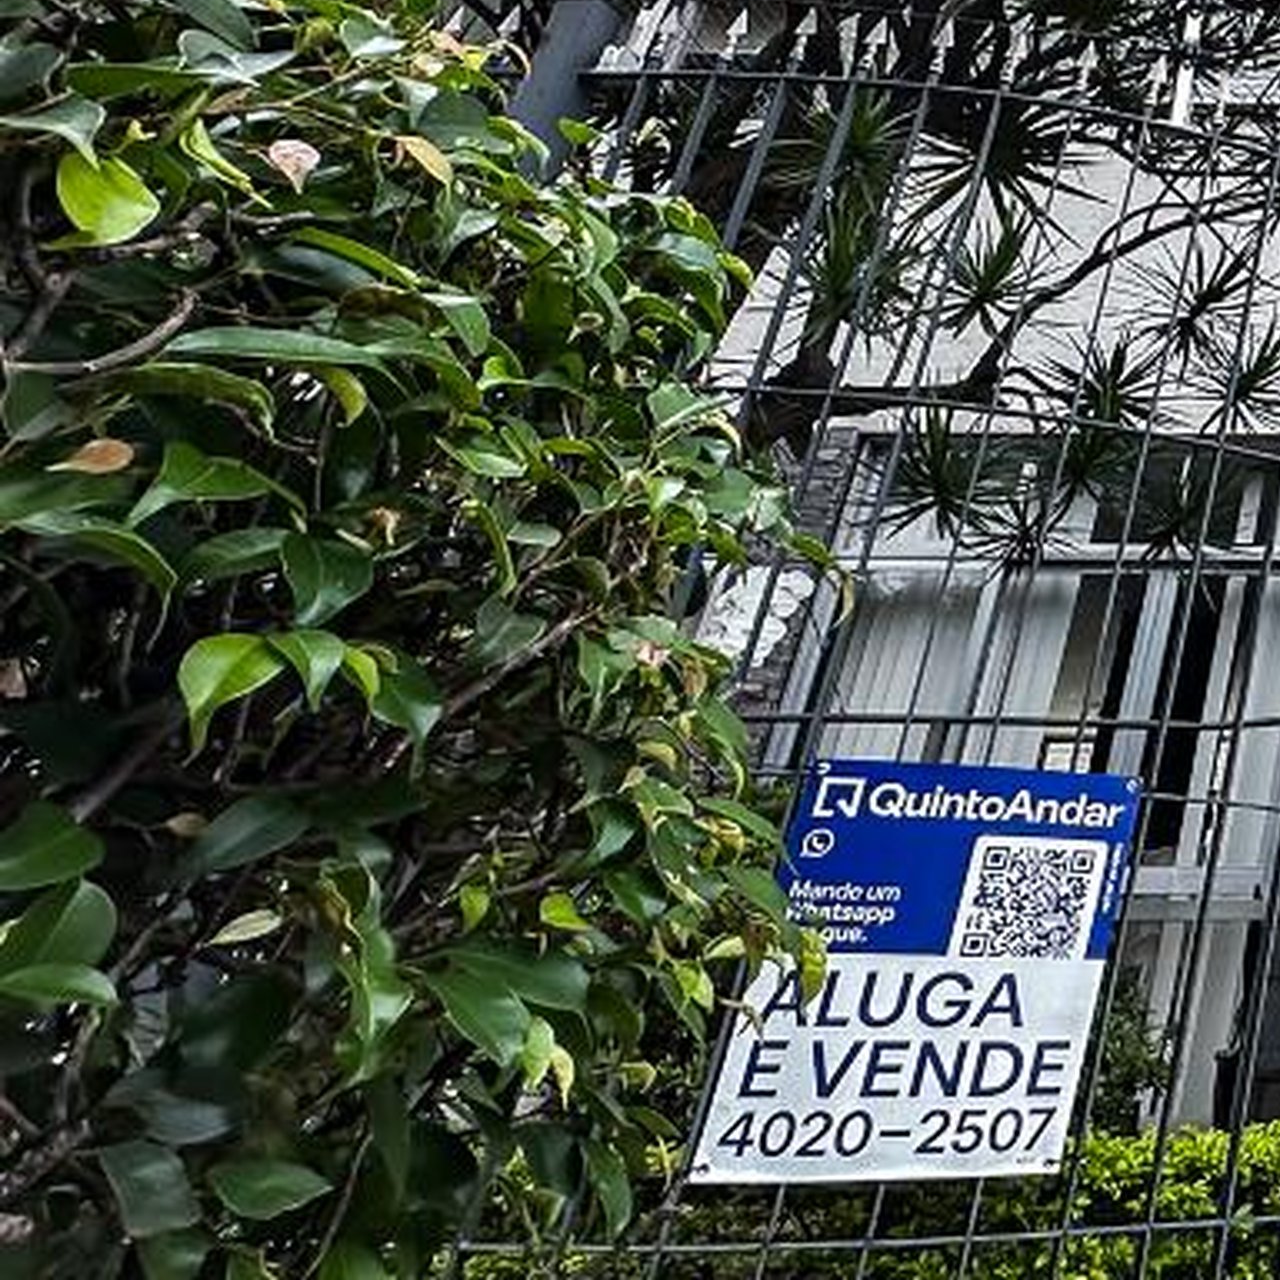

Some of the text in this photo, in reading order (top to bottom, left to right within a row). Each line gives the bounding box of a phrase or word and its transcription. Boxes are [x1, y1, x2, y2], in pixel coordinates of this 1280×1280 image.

[868, 781, 1125, 828] QuintoAndar
[789, 880, 902, 901] Mande um
[760, 970, 1024, 1028] ALUGA
[738, 1040, 1071, 1098] E VENDE
[718, 1107, 1057, 1158] 4020-2507
